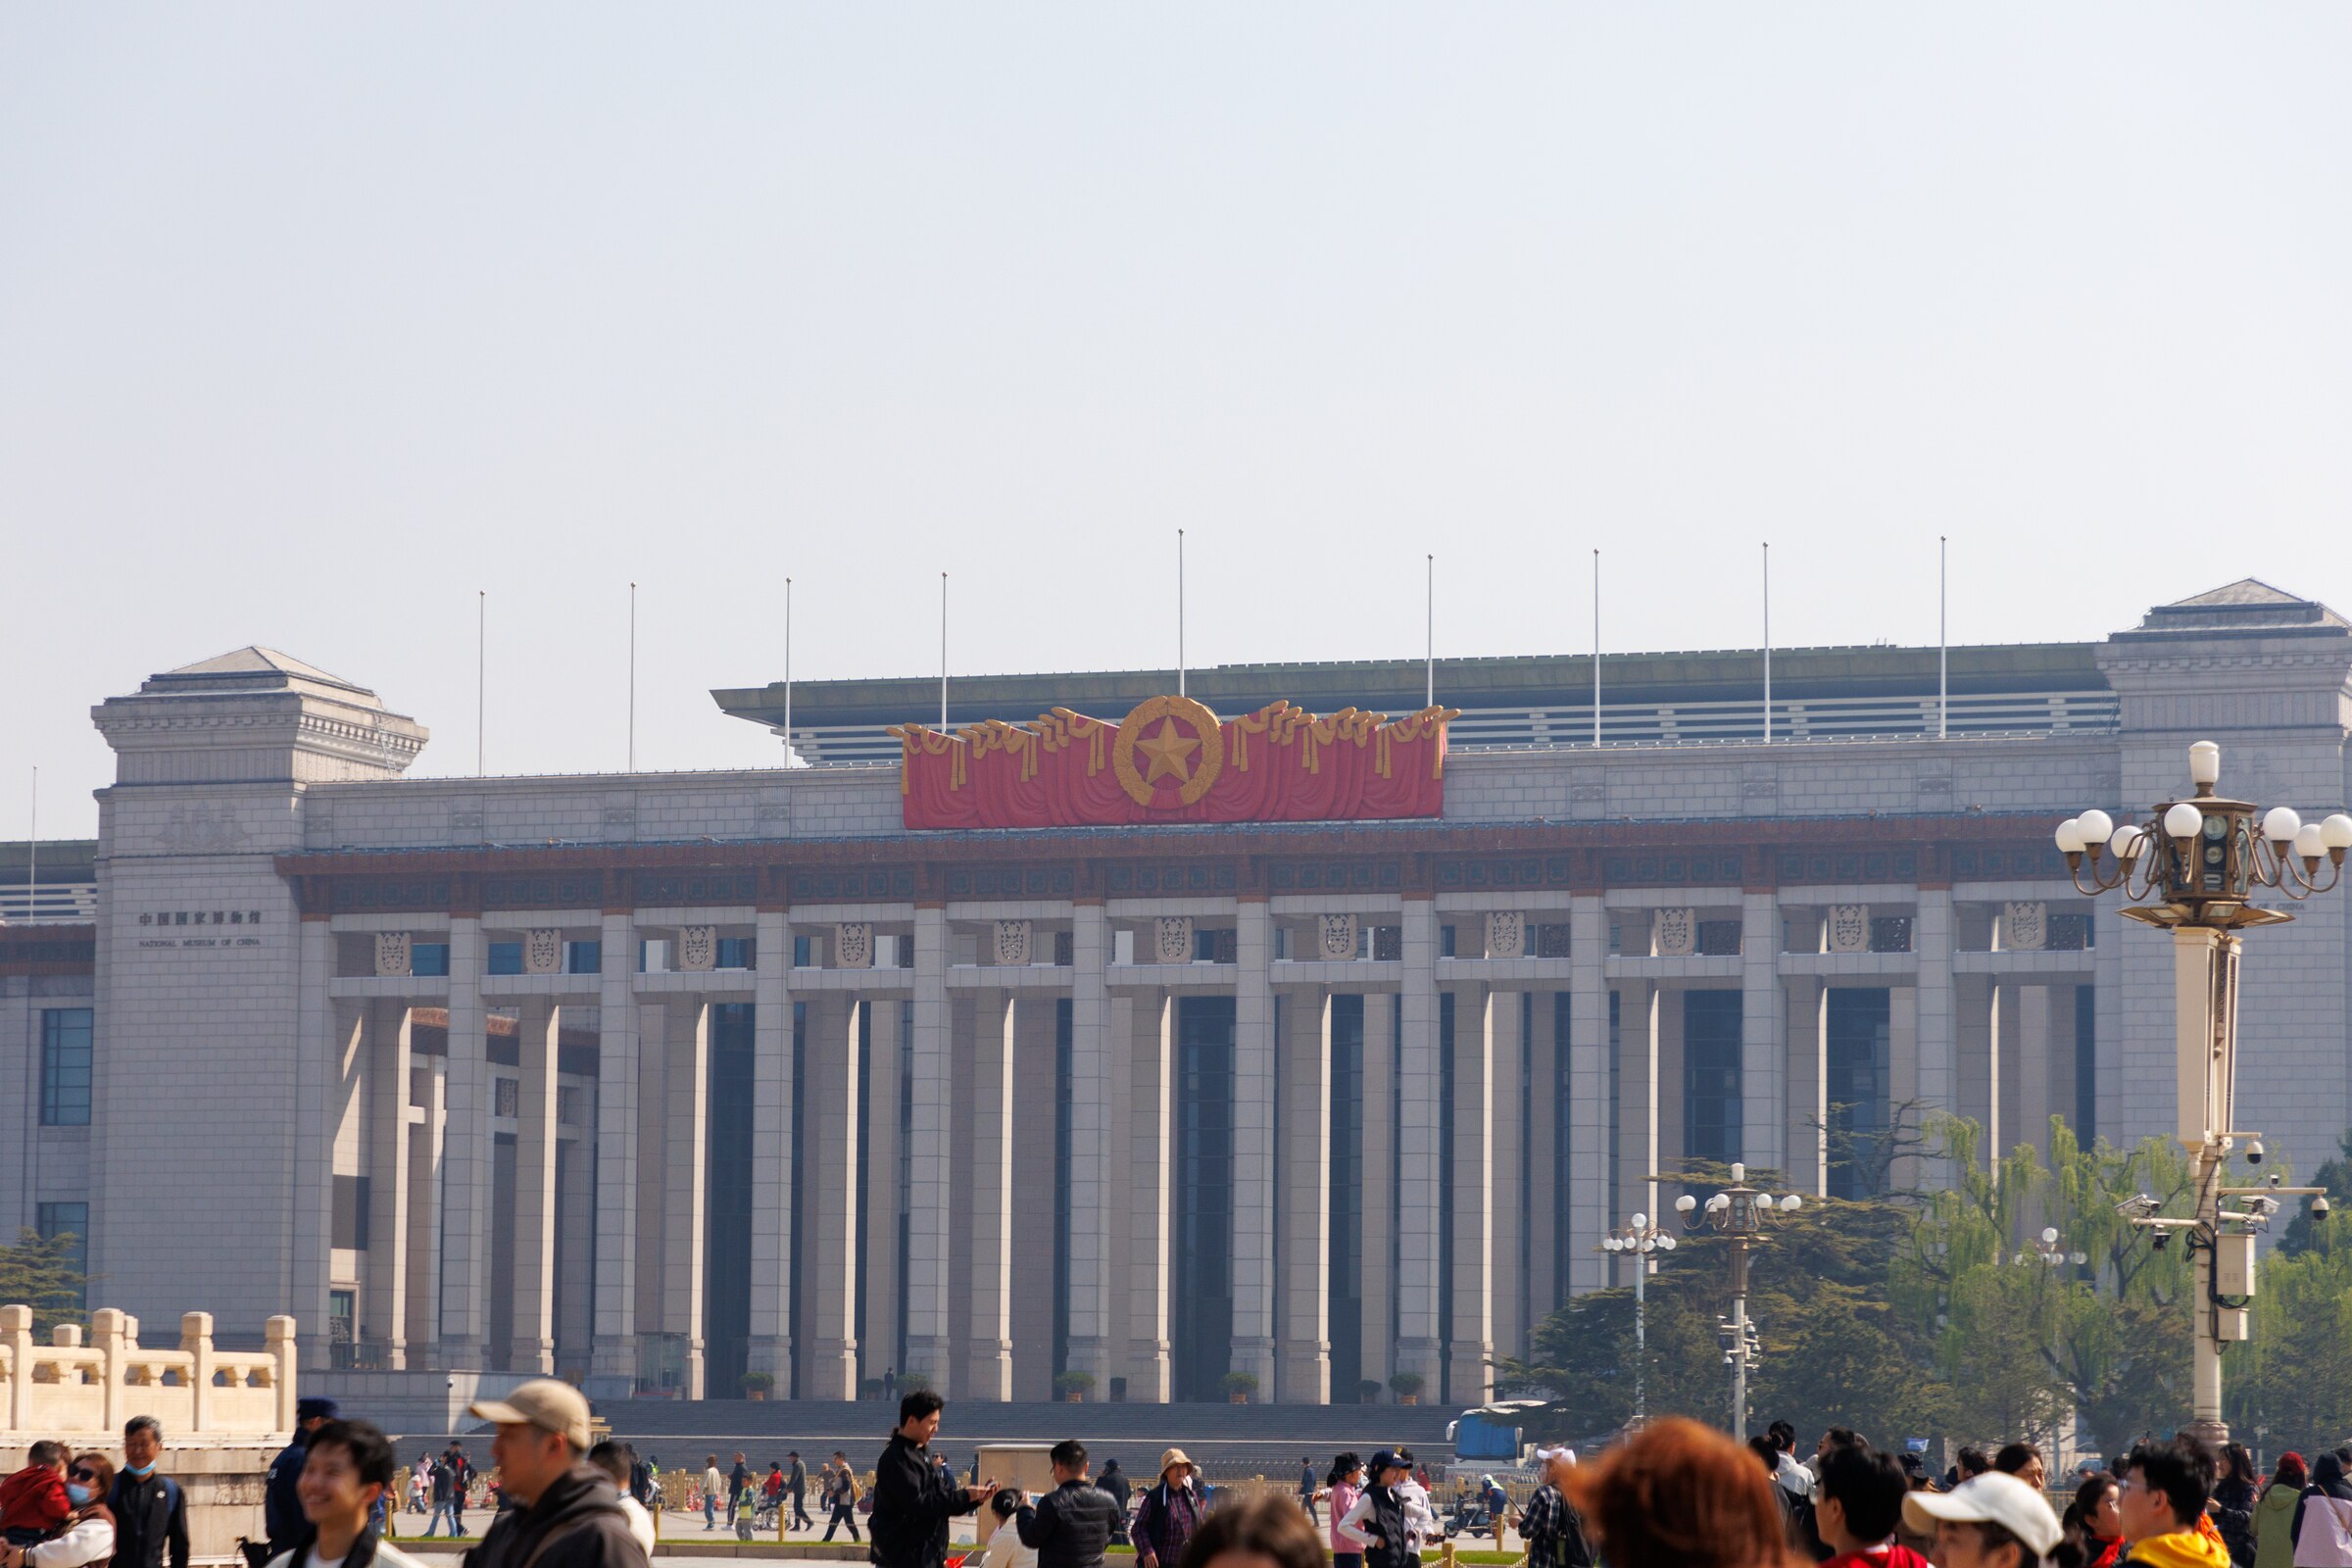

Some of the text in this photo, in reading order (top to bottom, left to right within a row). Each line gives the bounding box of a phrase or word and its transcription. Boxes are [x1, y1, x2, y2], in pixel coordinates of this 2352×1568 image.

[2277, 902, 2305, 910] CHINA
[139, 910, 261, 926] 中国国家博物馆
